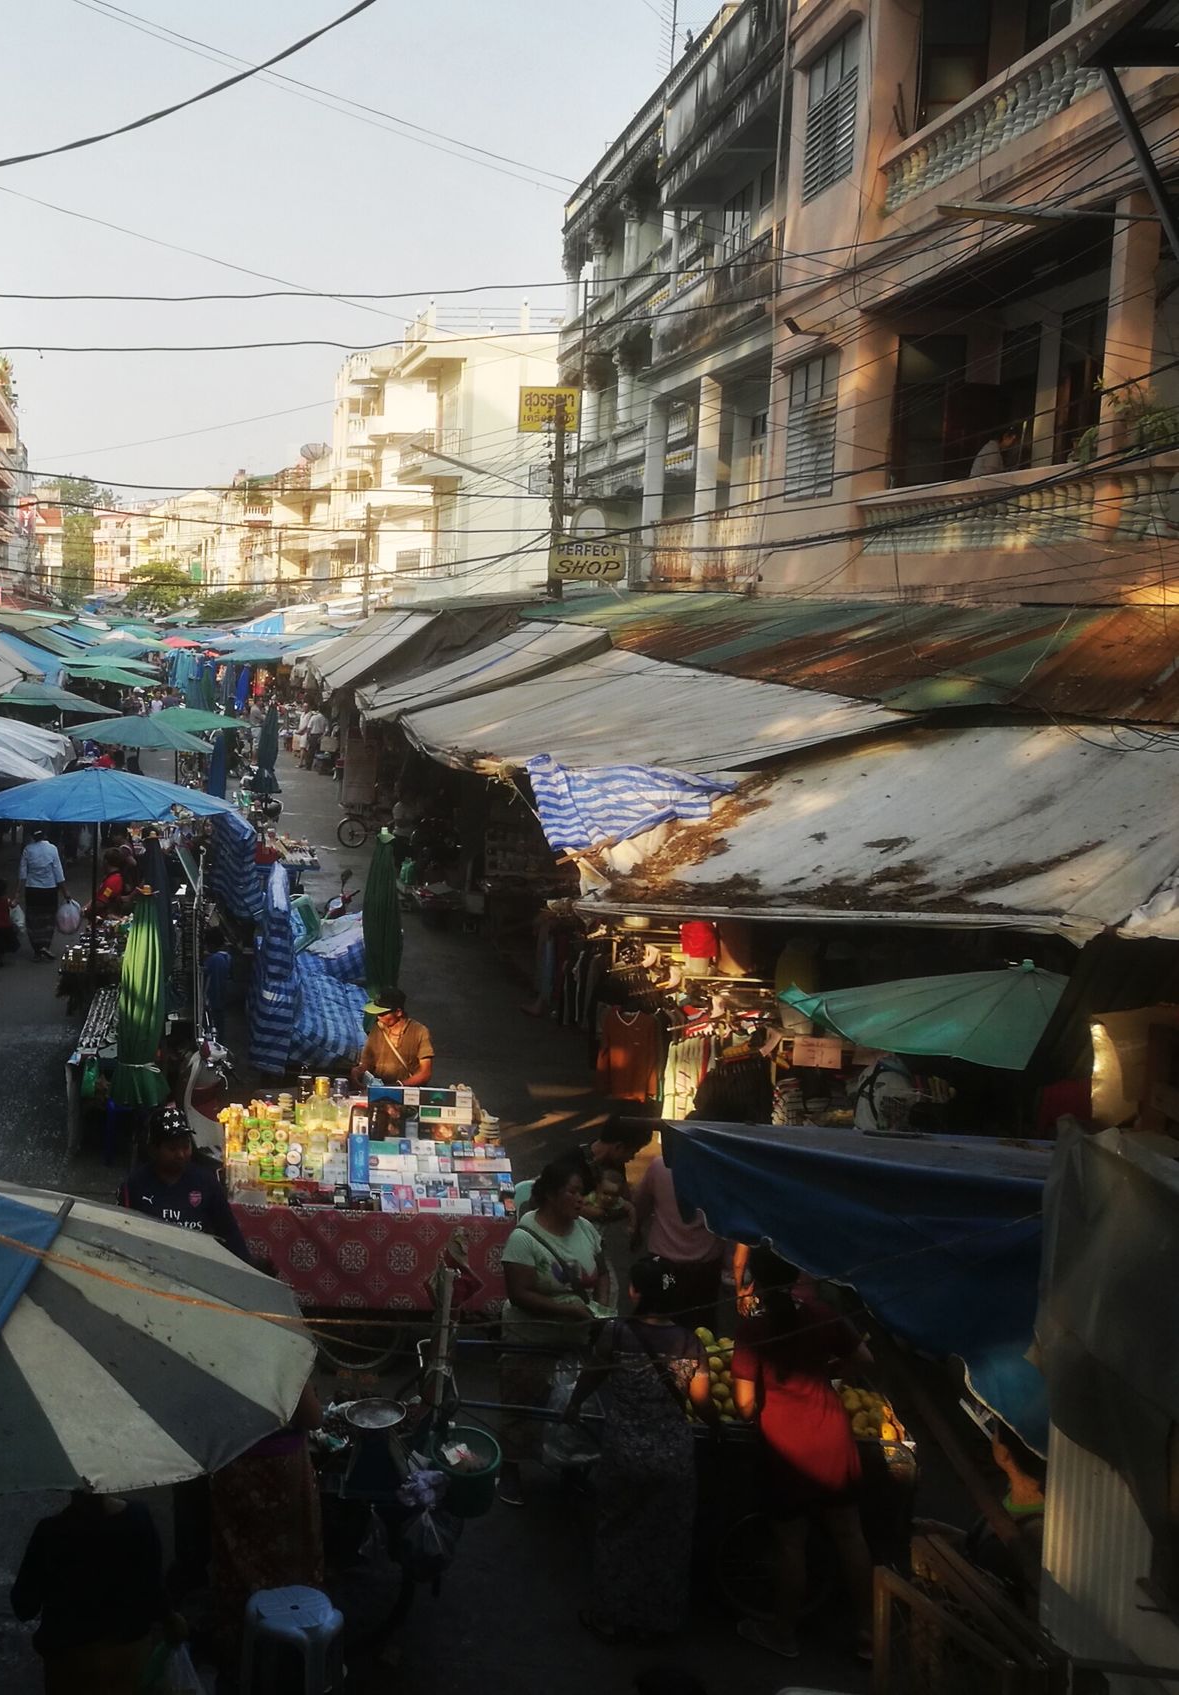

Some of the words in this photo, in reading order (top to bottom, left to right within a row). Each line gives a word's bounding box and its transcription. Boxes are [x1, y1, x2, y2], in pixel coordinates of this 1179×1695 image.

[557, 544, 618, 557] PERFECT
[555, 560, 620, 575] SHOP
[162, 1209, 180, 1220] Fly
